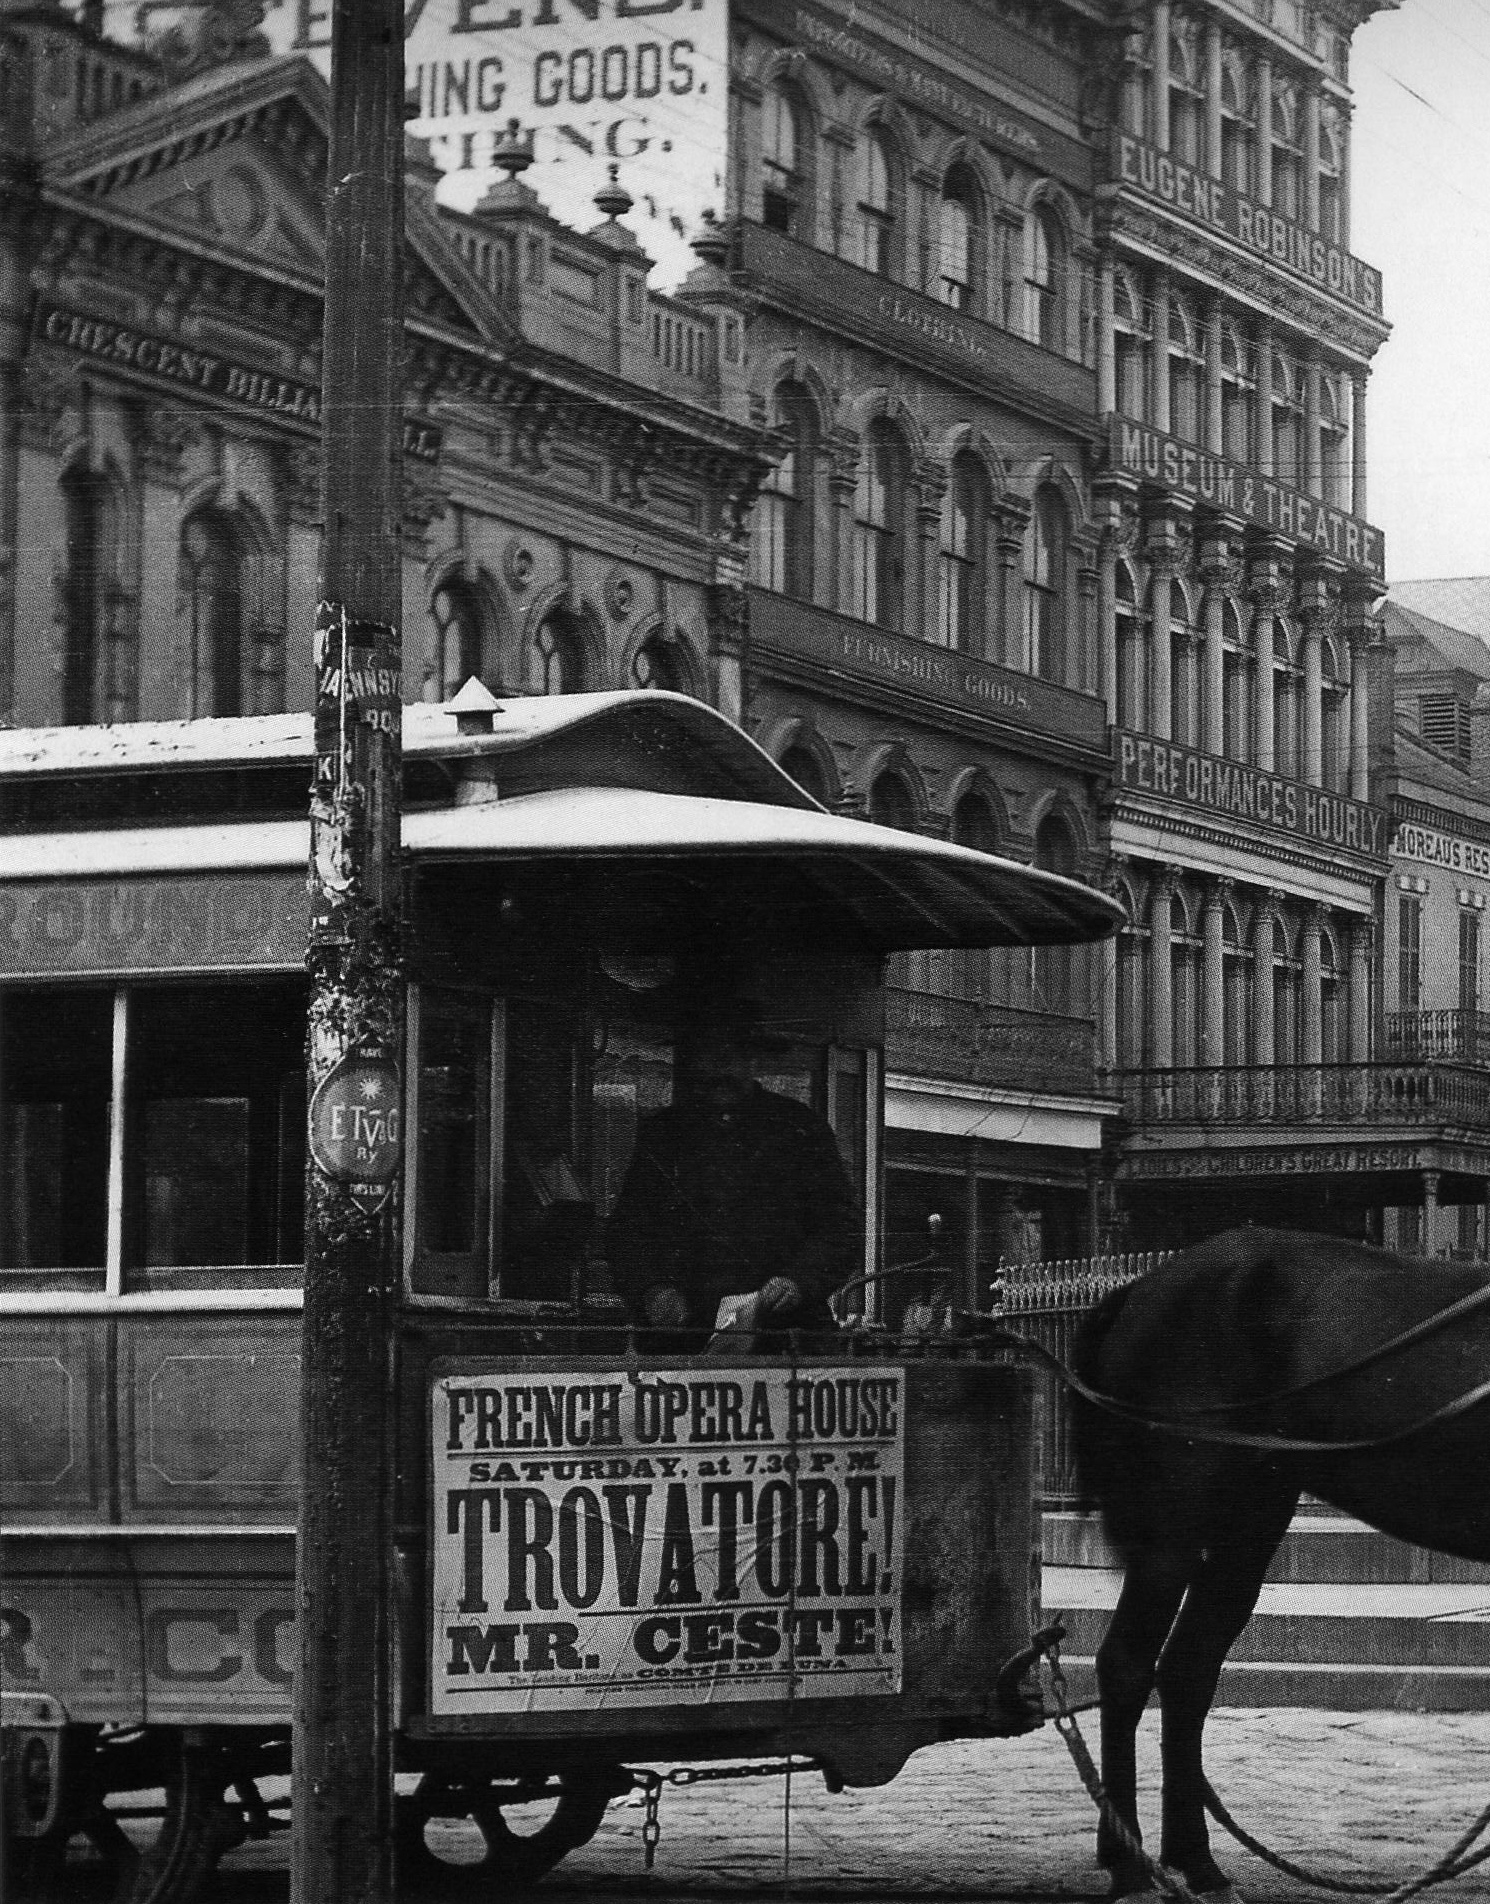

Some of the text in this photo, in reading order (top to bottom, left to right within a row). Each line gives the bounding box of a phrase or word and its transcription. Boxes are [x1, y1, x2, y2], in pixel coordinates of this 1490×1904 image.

[534, 39, 708, 108] GOODS.
[1120, 136, 1376, 309] EUGENE ROBINSON'S
[46, 311, 220, 386] CRESCENT
[225, 366, 323, 421] BILLIA
[1121, 422, 1235, 509] MUSEUM
[1243, 478, 1254, 517] &
[1121, 735, 1382, 854] PERFORMANCES HOURLY
[1301, 1150, 1350, 1171] GREAT
[446, 1378, 899, 1449] FRENCH OPERA HOUSE
[469, 1457, 689, 1482] SATURDAY,
[698, 1456, 732, 1477] at
[743, 1454, 800, 1475] 7.30
[446, 1475, 897, 1614] TROVATORE!
[446, 1606, 896, 1676] MR. CESTE!
[636, 1663, 731, 1679] COMTE
[736, 1661, 773, 1674] DE
